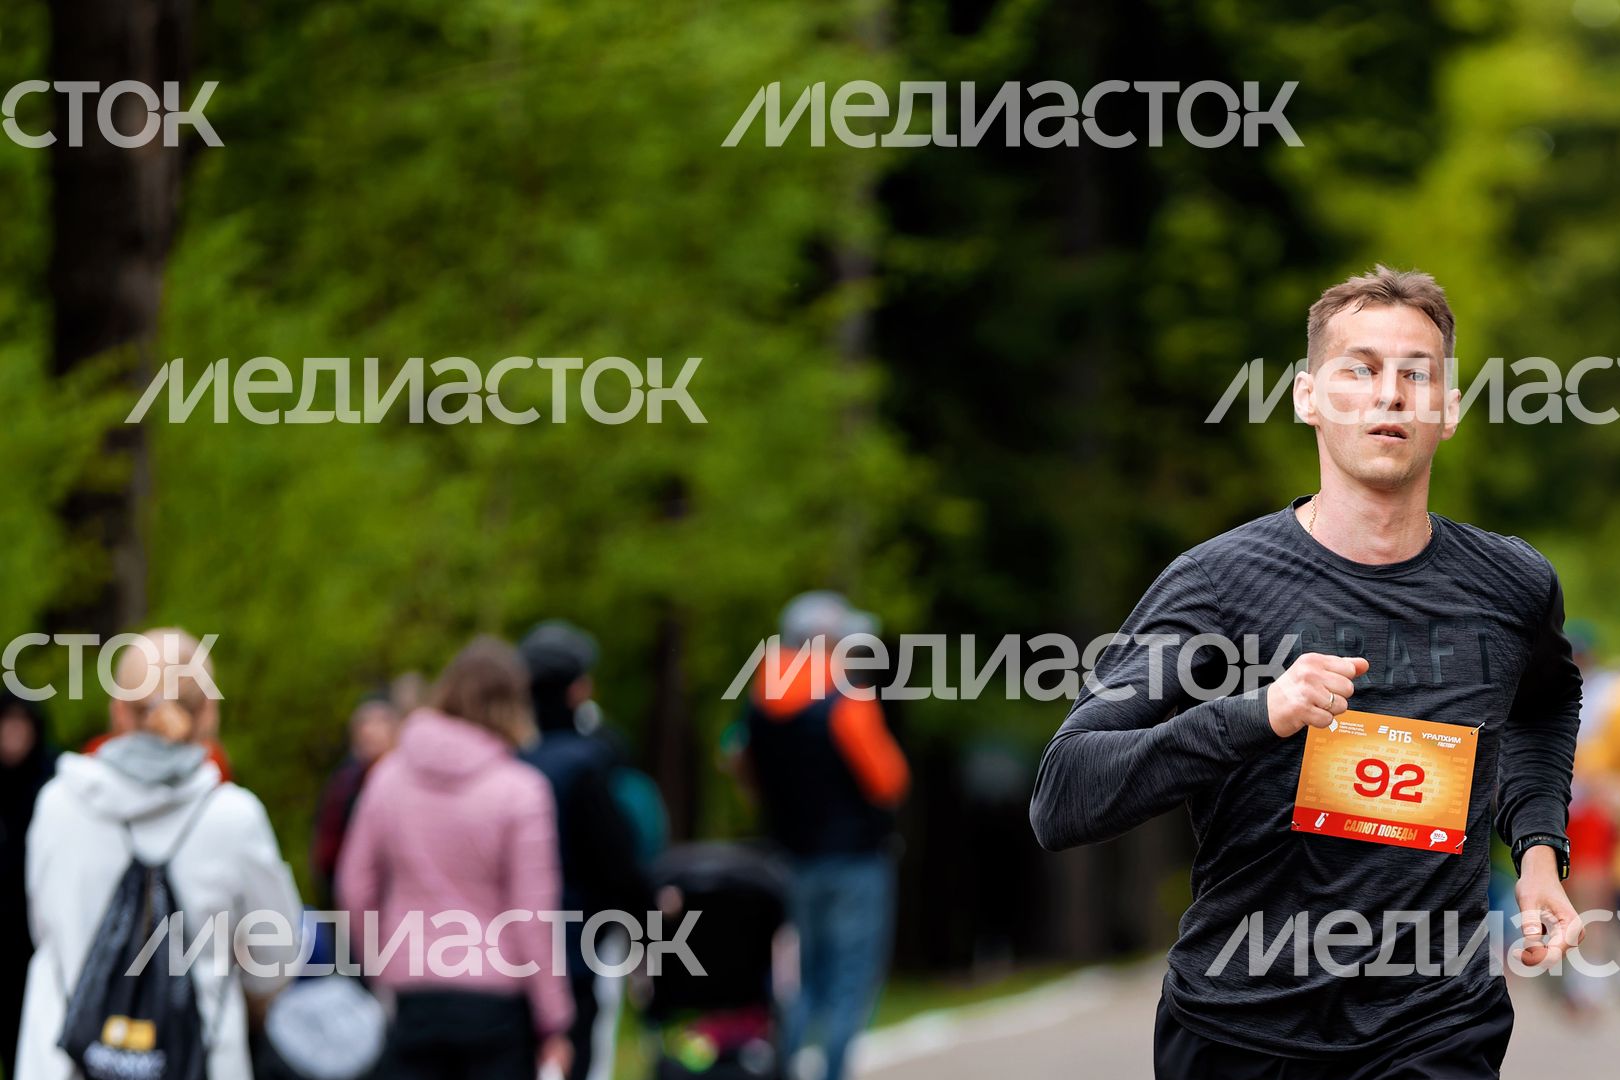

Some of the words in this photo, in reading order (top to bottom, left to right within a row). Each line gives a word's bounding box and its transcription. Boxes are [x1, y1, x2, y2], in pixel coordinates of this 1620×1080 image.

[1388, 729, 1412, 744] ВТБ
[1422, 732, 1462, 744] УРАЛХИМ
[1353, 758, 1426, 803] 92
[1344, 819, 1379, 835] САЛЮТ
[1377, 824, 1418, 841] ПОБЕДЫ
